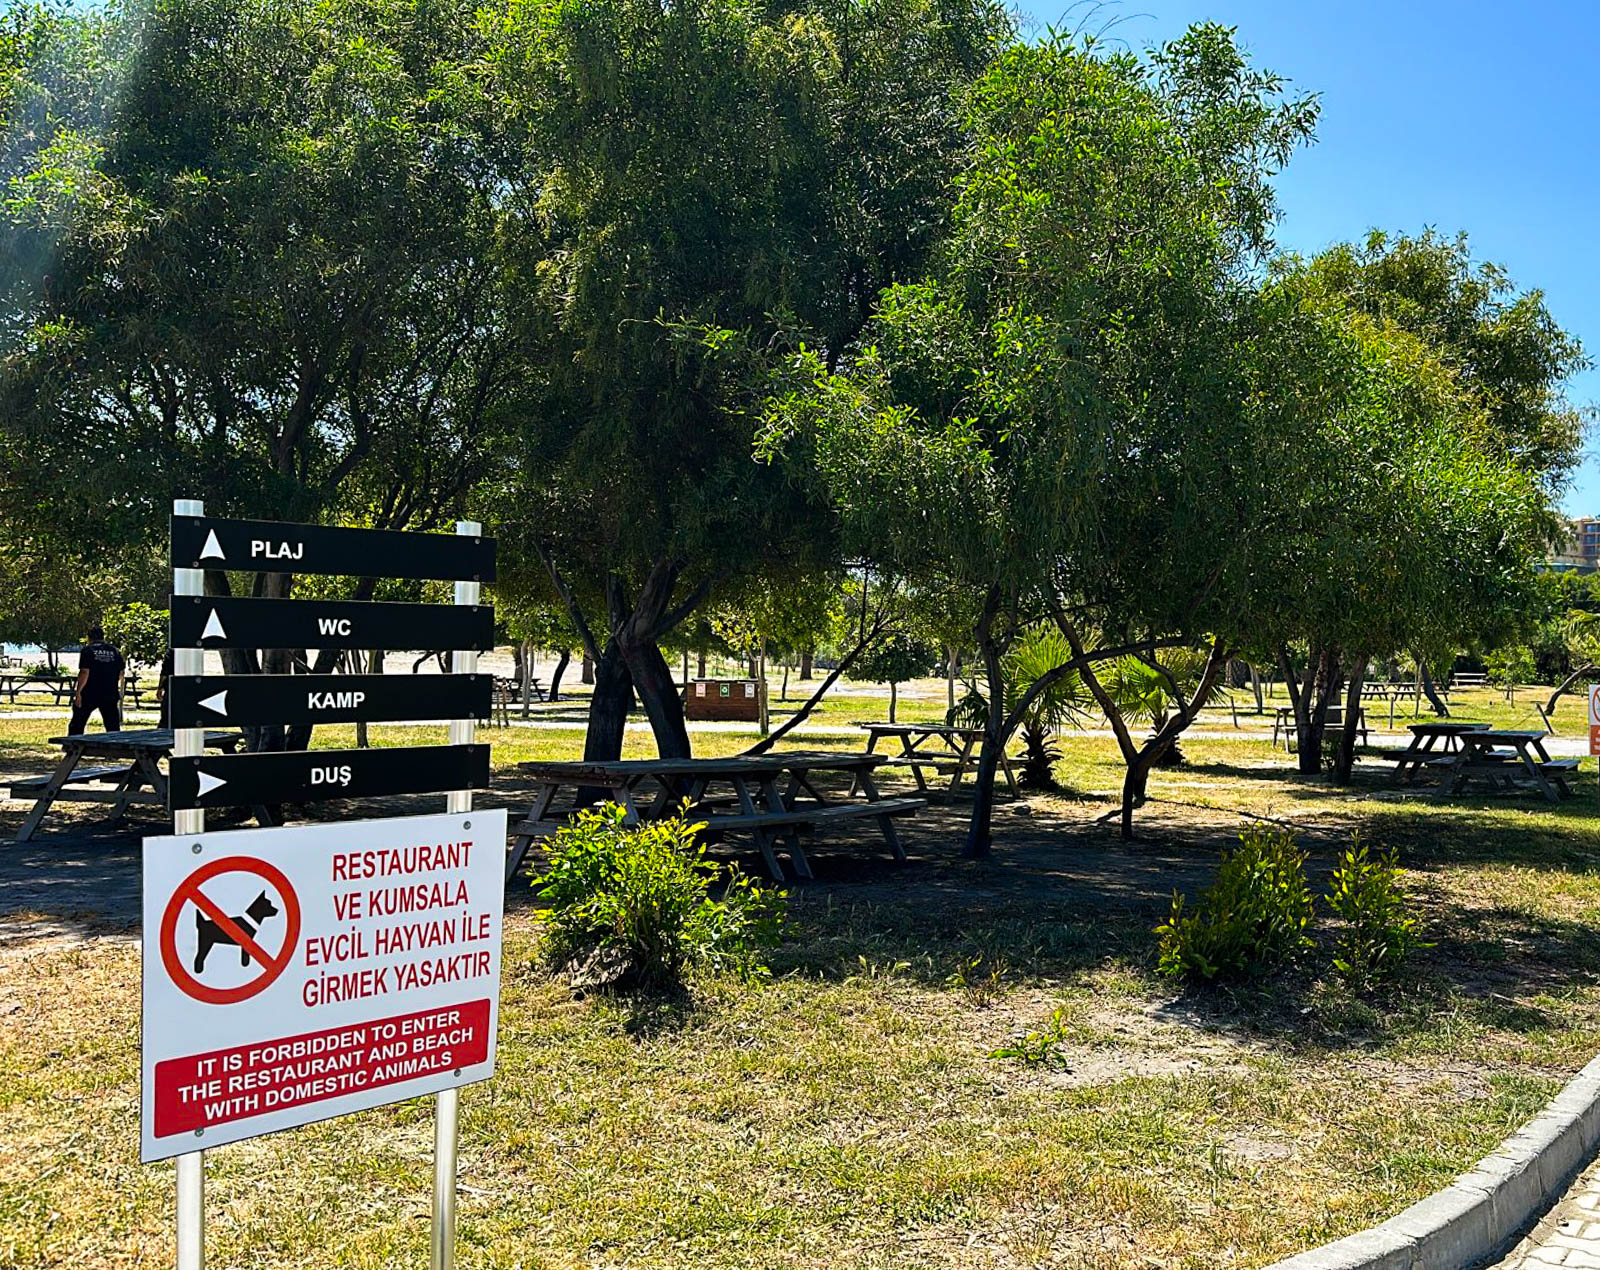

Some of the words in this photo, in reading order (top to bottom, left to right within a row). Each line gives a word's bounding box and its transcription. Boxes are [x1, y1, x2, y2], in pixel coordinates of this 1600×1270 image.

[251, 540, 303, 559] PLAJ
[318, 618, 351, 636] WC
[308, 691, 365, 709] KAMP
[311, 766, 352, 786] DUŞ
[332, 842, 473, 881] RESTAURANT
[333, 893, 362, 921] VE
[369, 880, 469, 917] KUMSALA
[305, 926, 369, 967] EVCİL
[375, 918, 455, 956] HAYVAN
[461, 911, 491, 942] İLE
[302, 967, 388, 1008] GİRMEK
[394, 951, 491, 992] YASAKTIR
[178, 1080, 222, 1103] THE
[228, 1052, 363, 1094] RESTAURANT
[368, 1043, 407, 1063] AND
[413, 1027, 474, 1054] BEACH
[197, 1058, 217, 1078] IT
[223, 1054, 242, 1072] IS
[249, 1029, 366, 1067] FORBIDDEN
[372, 1023, 397, 1042] TO
[401, 1011, 460, 1035] ENTER
[205, 1097, 259, 1121] WITH
[266, 1070, 367, 1108] DOMESTIC
[372, 1052, 453, 1081] ANIMALS
